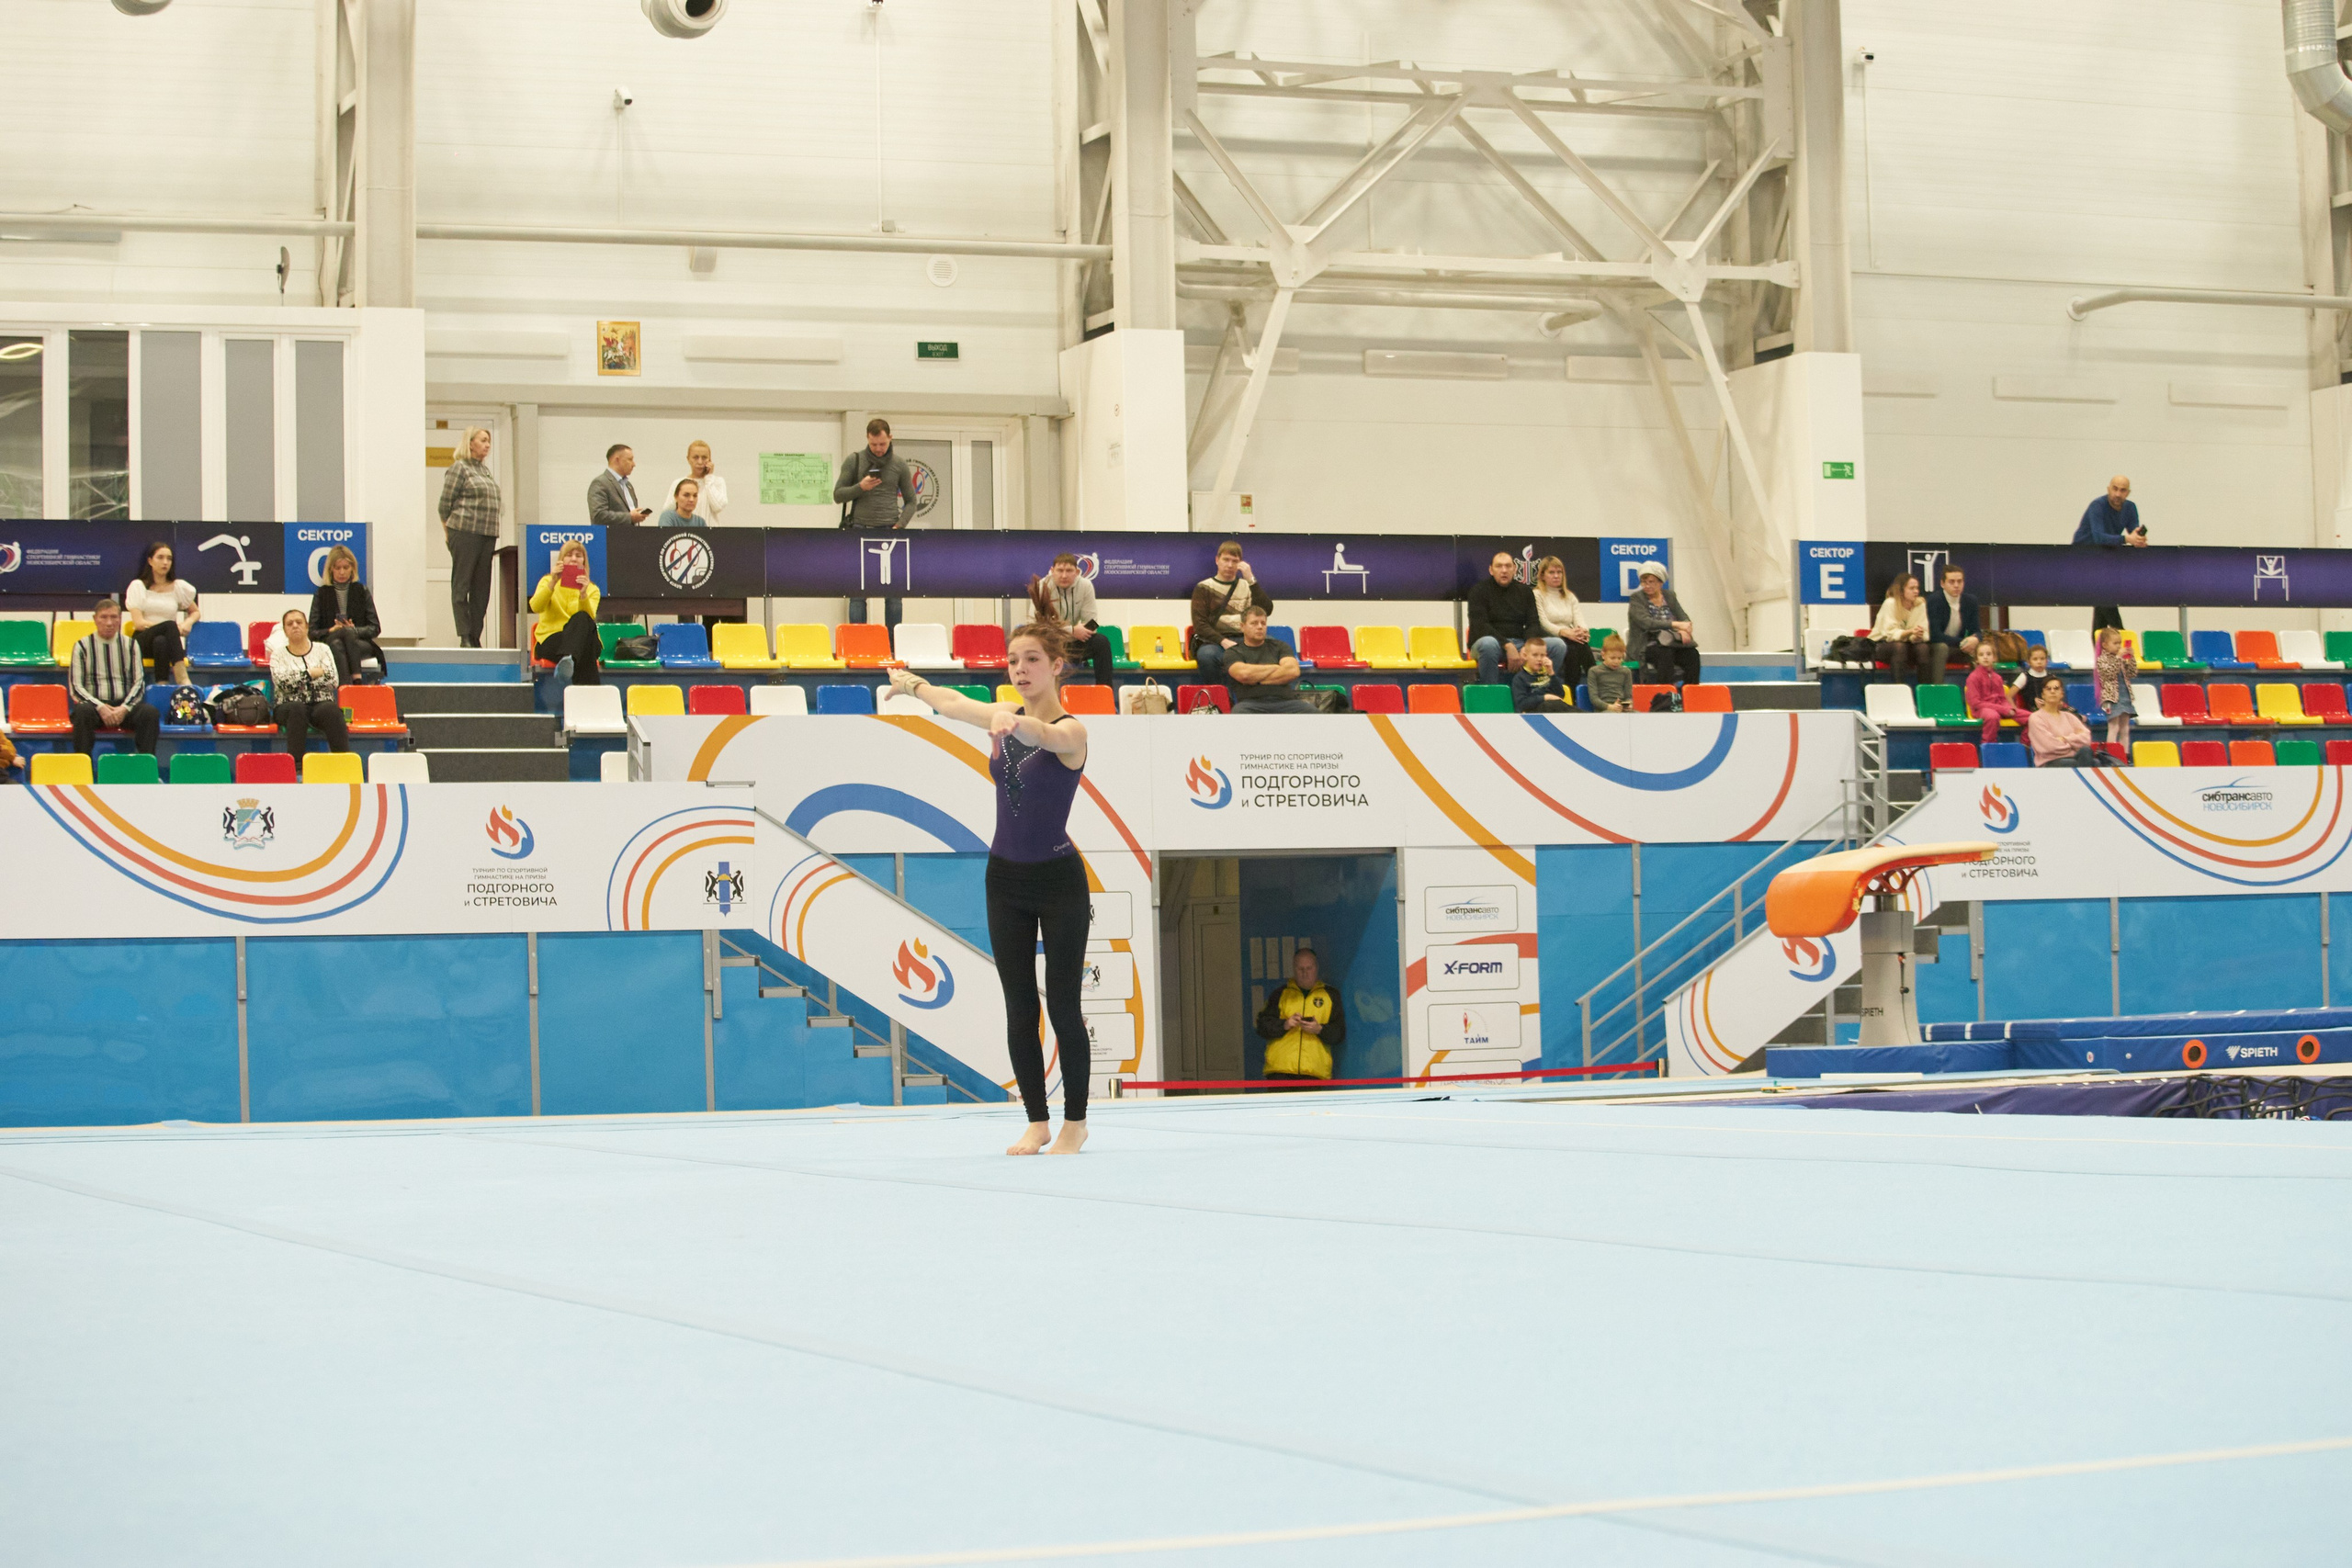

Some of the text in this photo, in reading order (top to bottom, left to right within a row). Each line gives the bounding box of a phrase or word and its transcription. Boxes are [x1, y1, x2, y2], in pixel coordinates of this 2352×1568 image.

[298, 529, 353, 541] СЕКТОР
[540, 532, 594, 544] СЕКТОР
[1611, 544, 1657, 555] СЕКТОР
[1809, 547, 1854, 558] СЕКТОР
[1820, 564, 1846, 598] E
[1242, 775, 1360, 791] ПОДГОРНОГО
[1254, 794, 1368, 807] СТРЕТОВИЧА
[2202, 791, 2273, 803] сибтрансавто
[2203, 802, 2272, 811] НОВОСИБИРСК
[1969, 869, 2038, 878] СТРЕТОВИЧА
[467, 883, 554, 894] ПОДГОРНОГО
[474, 897, 558, 906] СТРЕТОВИЧА
[1446, 907, 1498, 915] сибтрансавто
[1444, 960, 1502, 974] X-FORM
[1464, 1034, 1488, 1043] ТАЙМ
[2240, 1047, 2278, 1058] SPIETH
